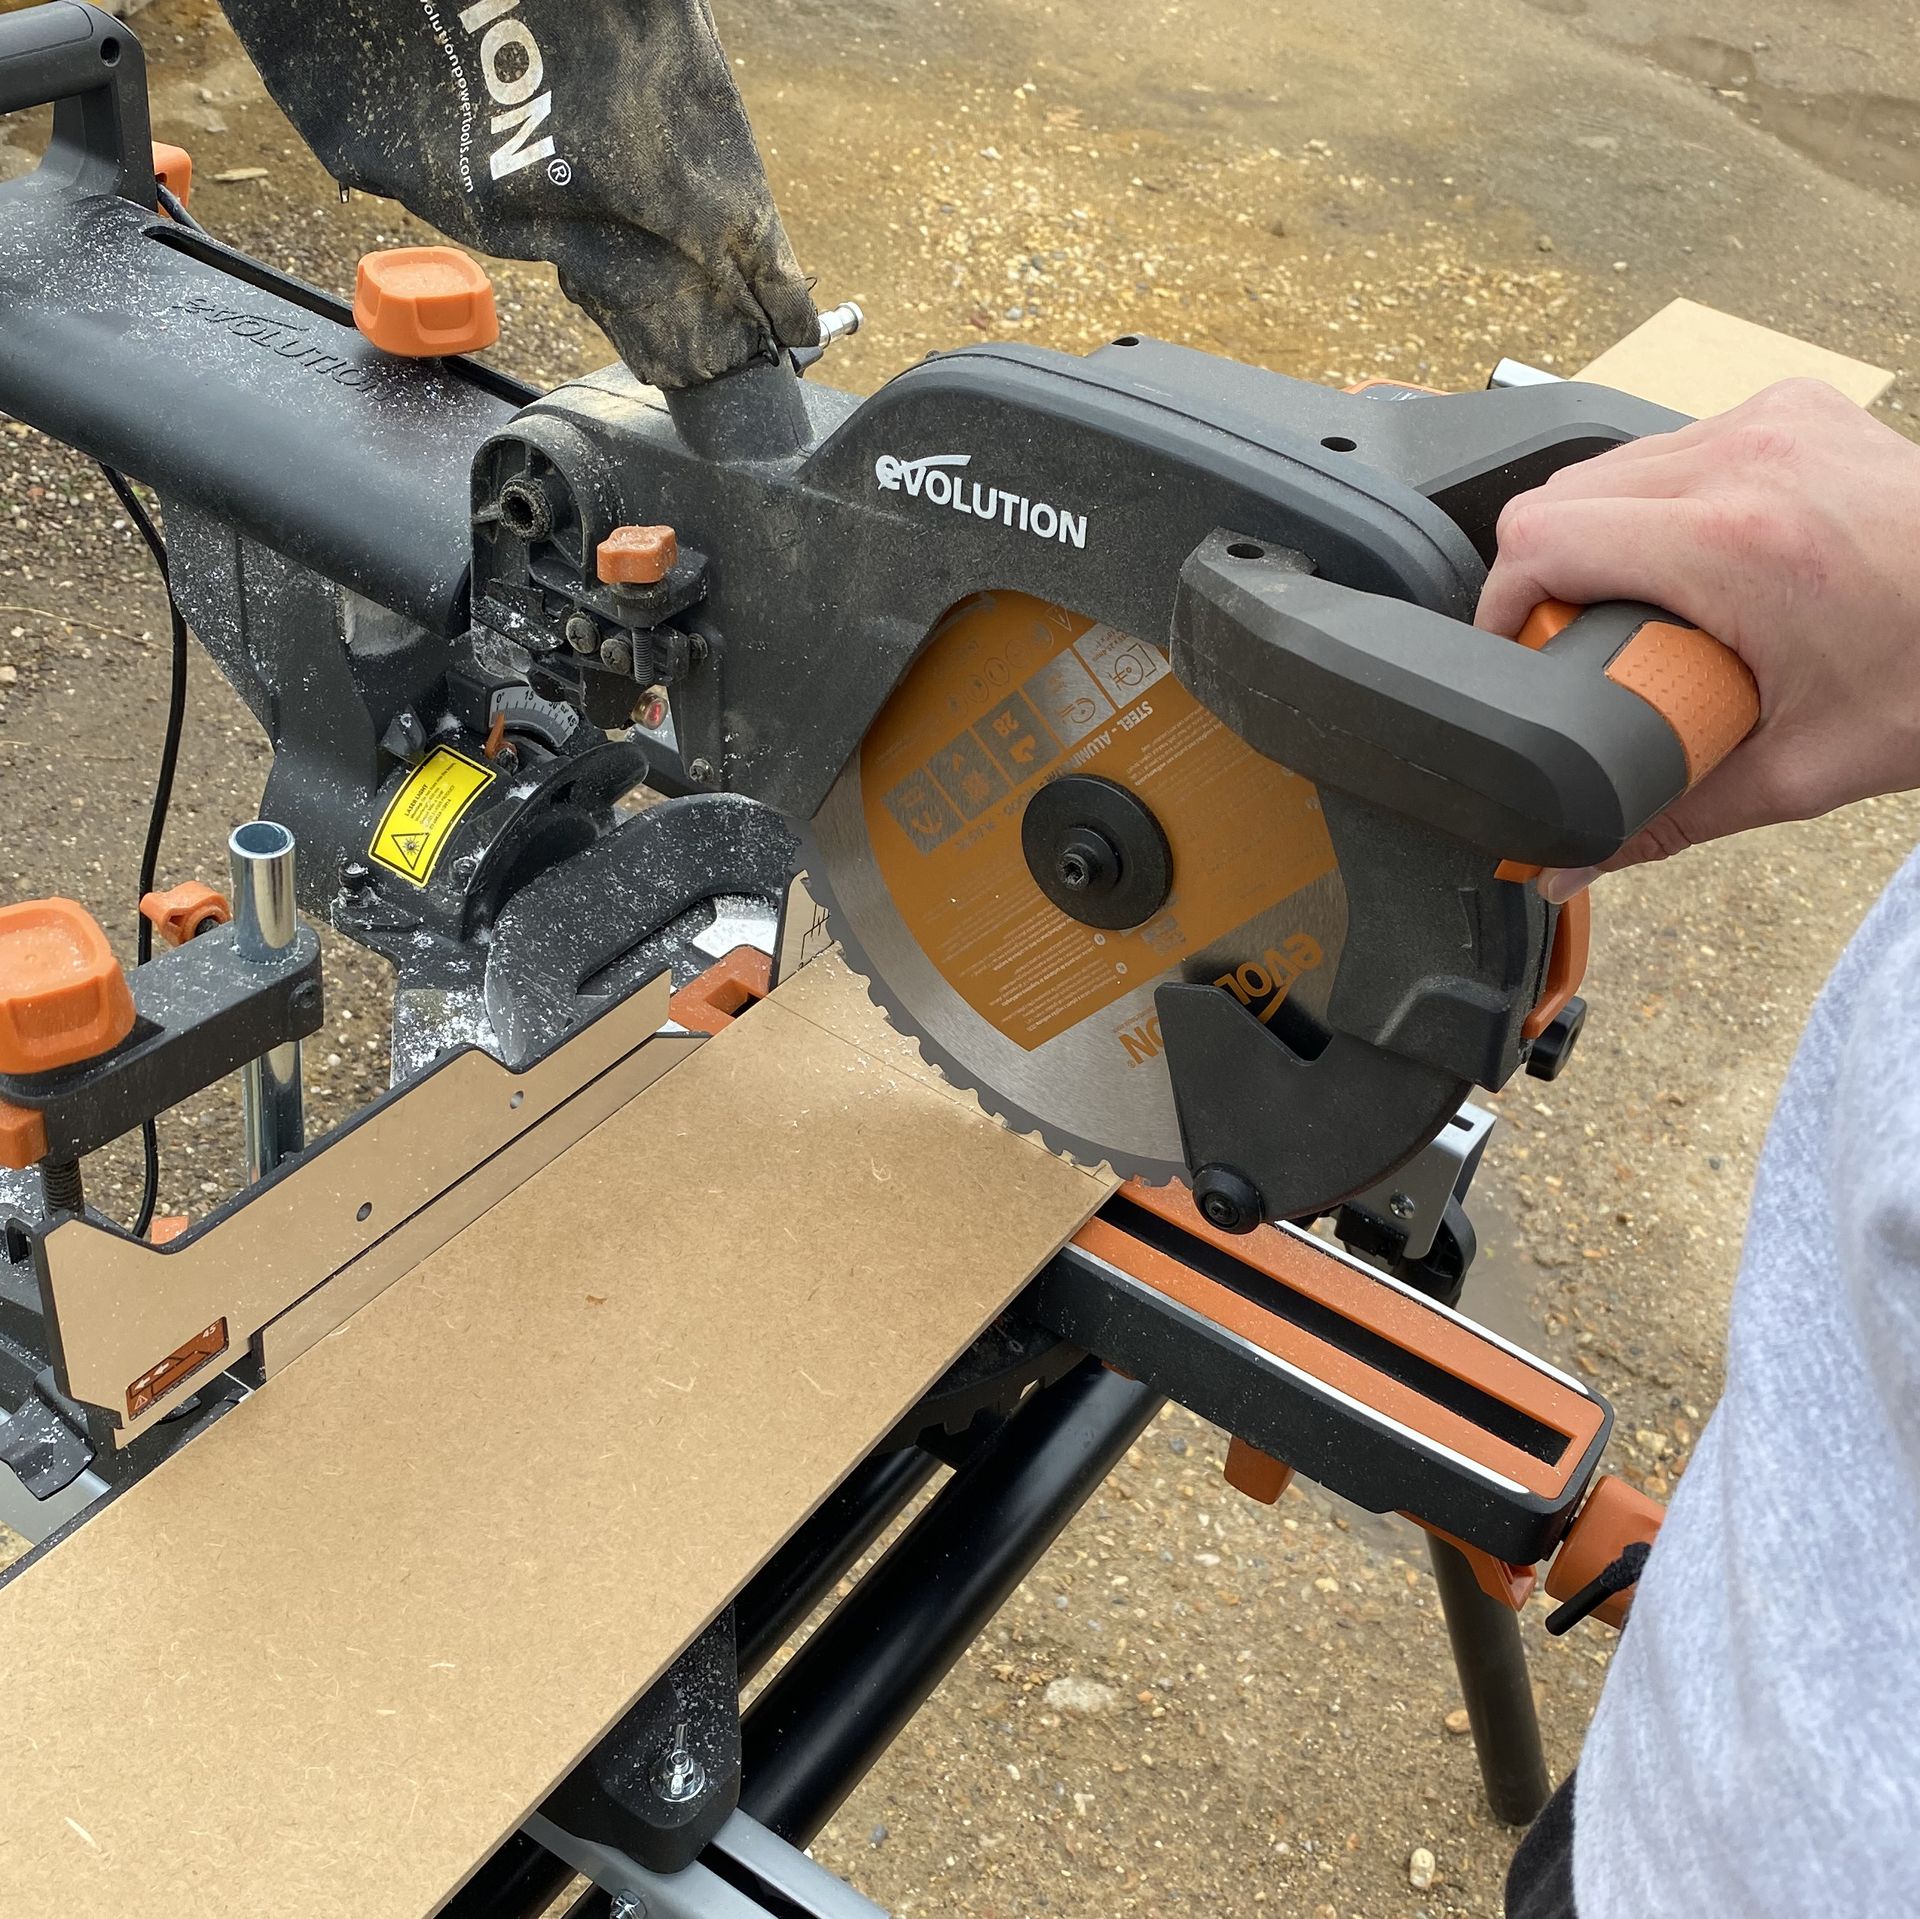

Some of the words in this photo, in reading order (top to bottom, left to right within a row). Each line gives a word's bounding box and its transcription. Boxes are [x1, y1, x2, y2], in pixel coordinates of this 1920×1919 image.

[421, 0, 474, 193] olutionpowertools.com
[992, 711, 1019, 737] 28
[1116, 700, 1154, 732] STEEL
